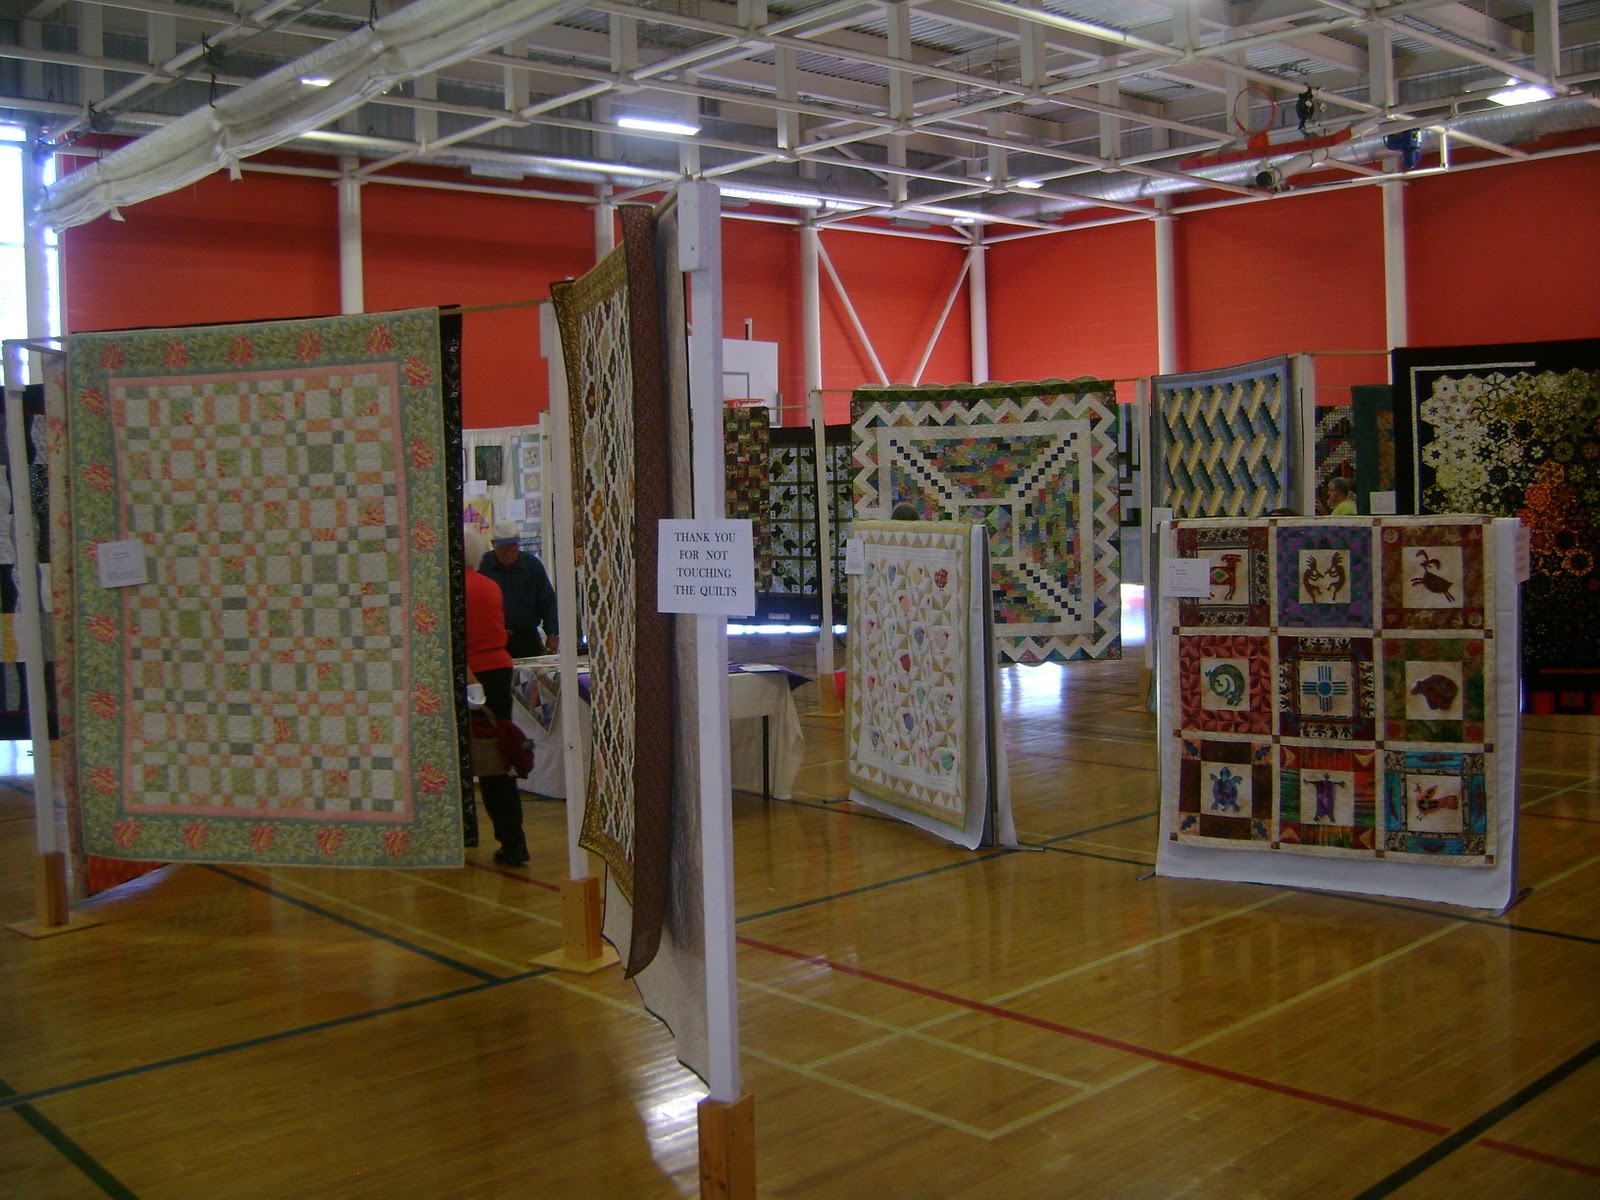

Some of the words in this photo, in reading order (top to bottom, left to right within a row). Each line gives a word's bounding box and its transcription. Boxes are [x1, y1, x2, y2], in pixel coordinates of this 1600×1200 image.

[674, 532, 710, 542] THANK
[715, 532, 736, 542] YOU
[679, 549, 699, 560] FOR
[706, 550, 728, 560] NOT
[676, 567, 731, 578] TOUCHING
[674, 585, 696, 595] THE
[700, 585, 737, 597] QUILTS
